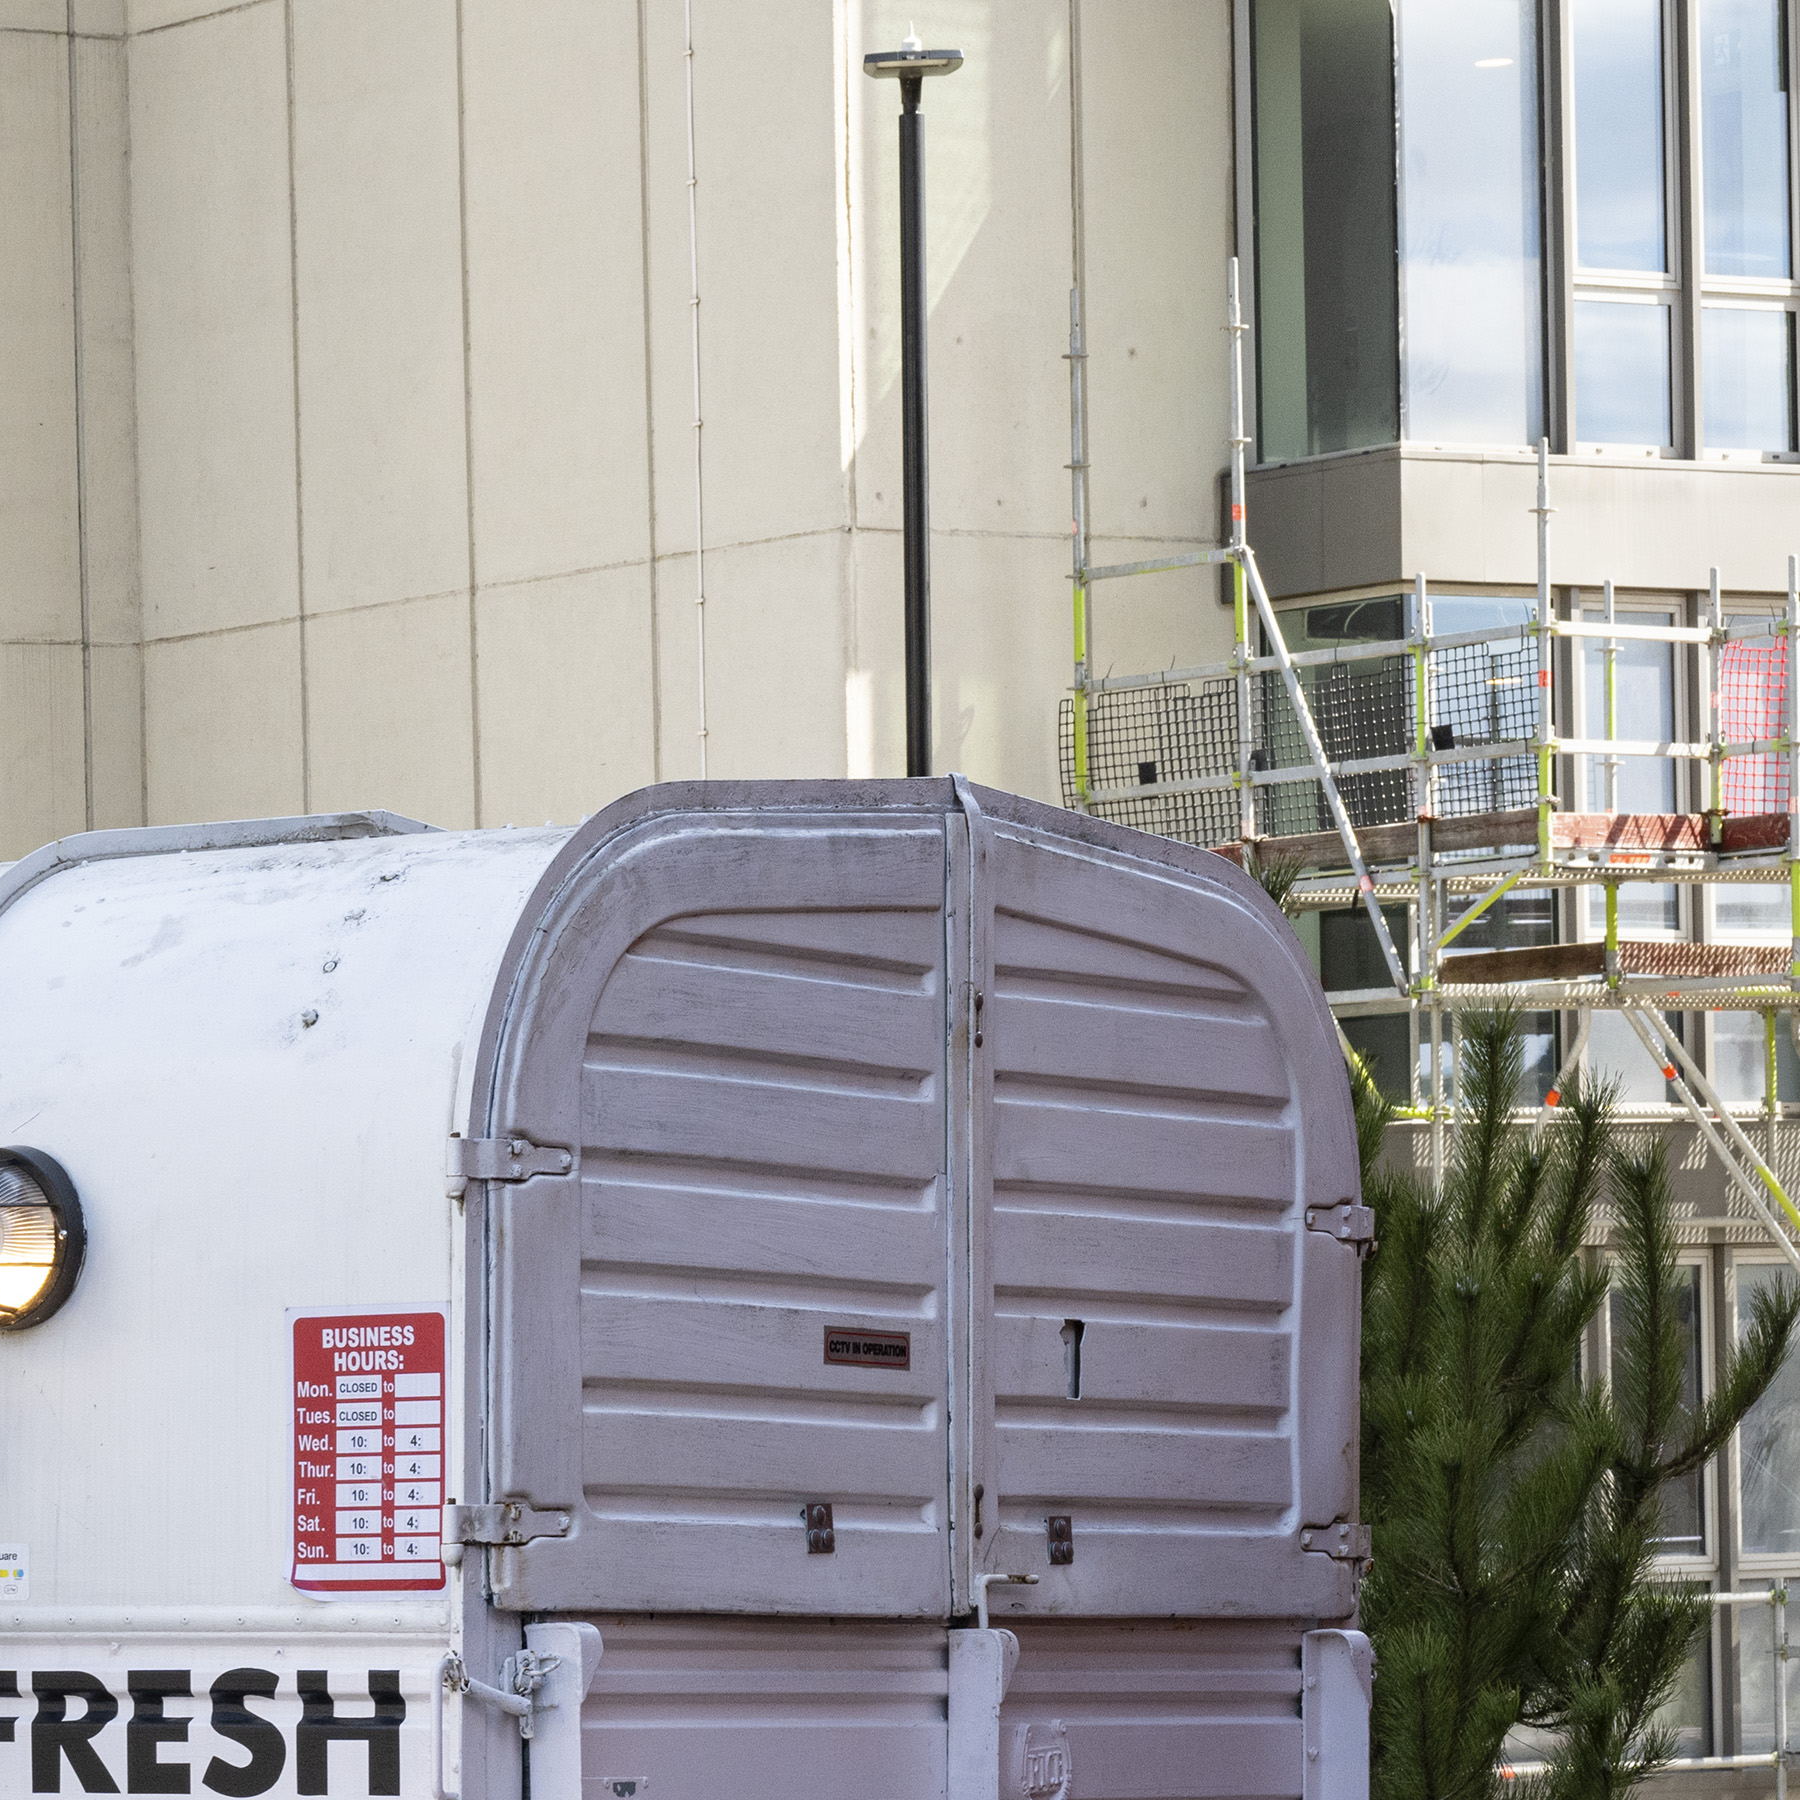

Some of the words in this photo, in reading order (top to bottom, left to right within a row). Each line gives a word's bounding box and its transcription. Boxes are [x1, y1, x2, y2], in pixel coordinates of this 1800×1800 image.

[321, 1325, 415, 1349] BUSINESS
[829, 1340, 851, 1354] CCTV
[852, 1341, 861, 1354] IN
[862, 1342, 907, 1357] OPERATION
[333, 1350, 404, 1372] HOURS:
[296, 1381, 333, 1398] Mon.
[339, 1382, 378, 1393] CLOSED
[383, 1380, 395, 1393] to
[296, 1407, 336, 1424] Tues.
[339, 1410, 378, 1422] CLOSED
[383, 1407, 395, 1420] to
[298, 1434, 334, 1451] Wed.
[351, 1436, 367, 1448] 10:
[383, 1434, 395, 1447] to
[298, 1461, 334, 1478] Thur.
[350, 1463, 367, 1475] 10:
[383, 1461, 395, 1474] to
[297, 1488, 321, 1505] Fri.
[352, 1489, 369, 1501] 10:
[383, 1488, 394, 1500] to
[297, 1515, 326, 1532] Sat.
[352, 1517, 369, 1529] 10:
[383, 1515, 394, 1527] to
[297, 1542, 329, 1559] Sun.
[353, 1543, 370, 1555] 10:
[383, 1543, 394, 1555] to
